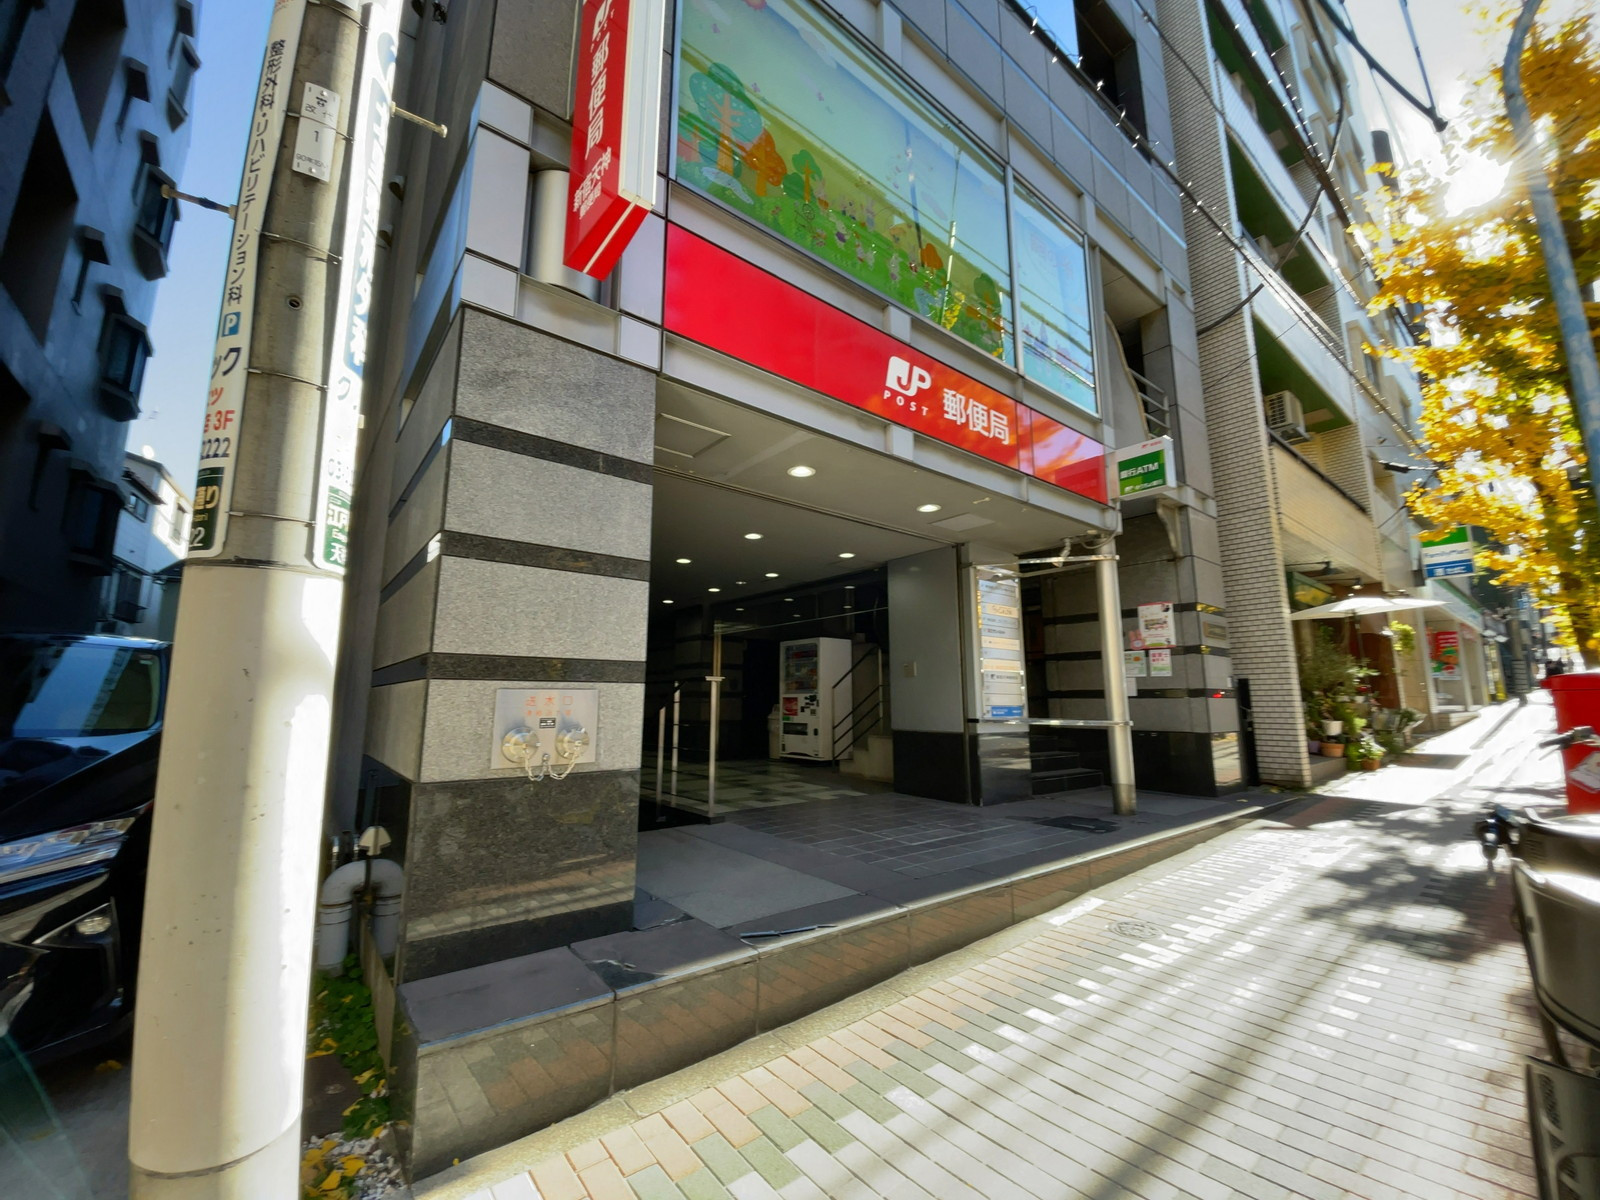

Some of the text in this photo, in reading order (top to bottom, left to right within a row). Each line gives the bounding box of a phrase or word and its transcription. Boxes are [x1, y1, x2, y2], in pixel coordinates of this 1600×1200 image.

[585, 31, 610, 161] 郵便局
[227, 39, 286, 305] 整形外科・リハビリテーション科
[883, 390, 929, 416] POST
[885, 356, 932, 397] JP
[943, 388, 1010, 446] 郵便局
